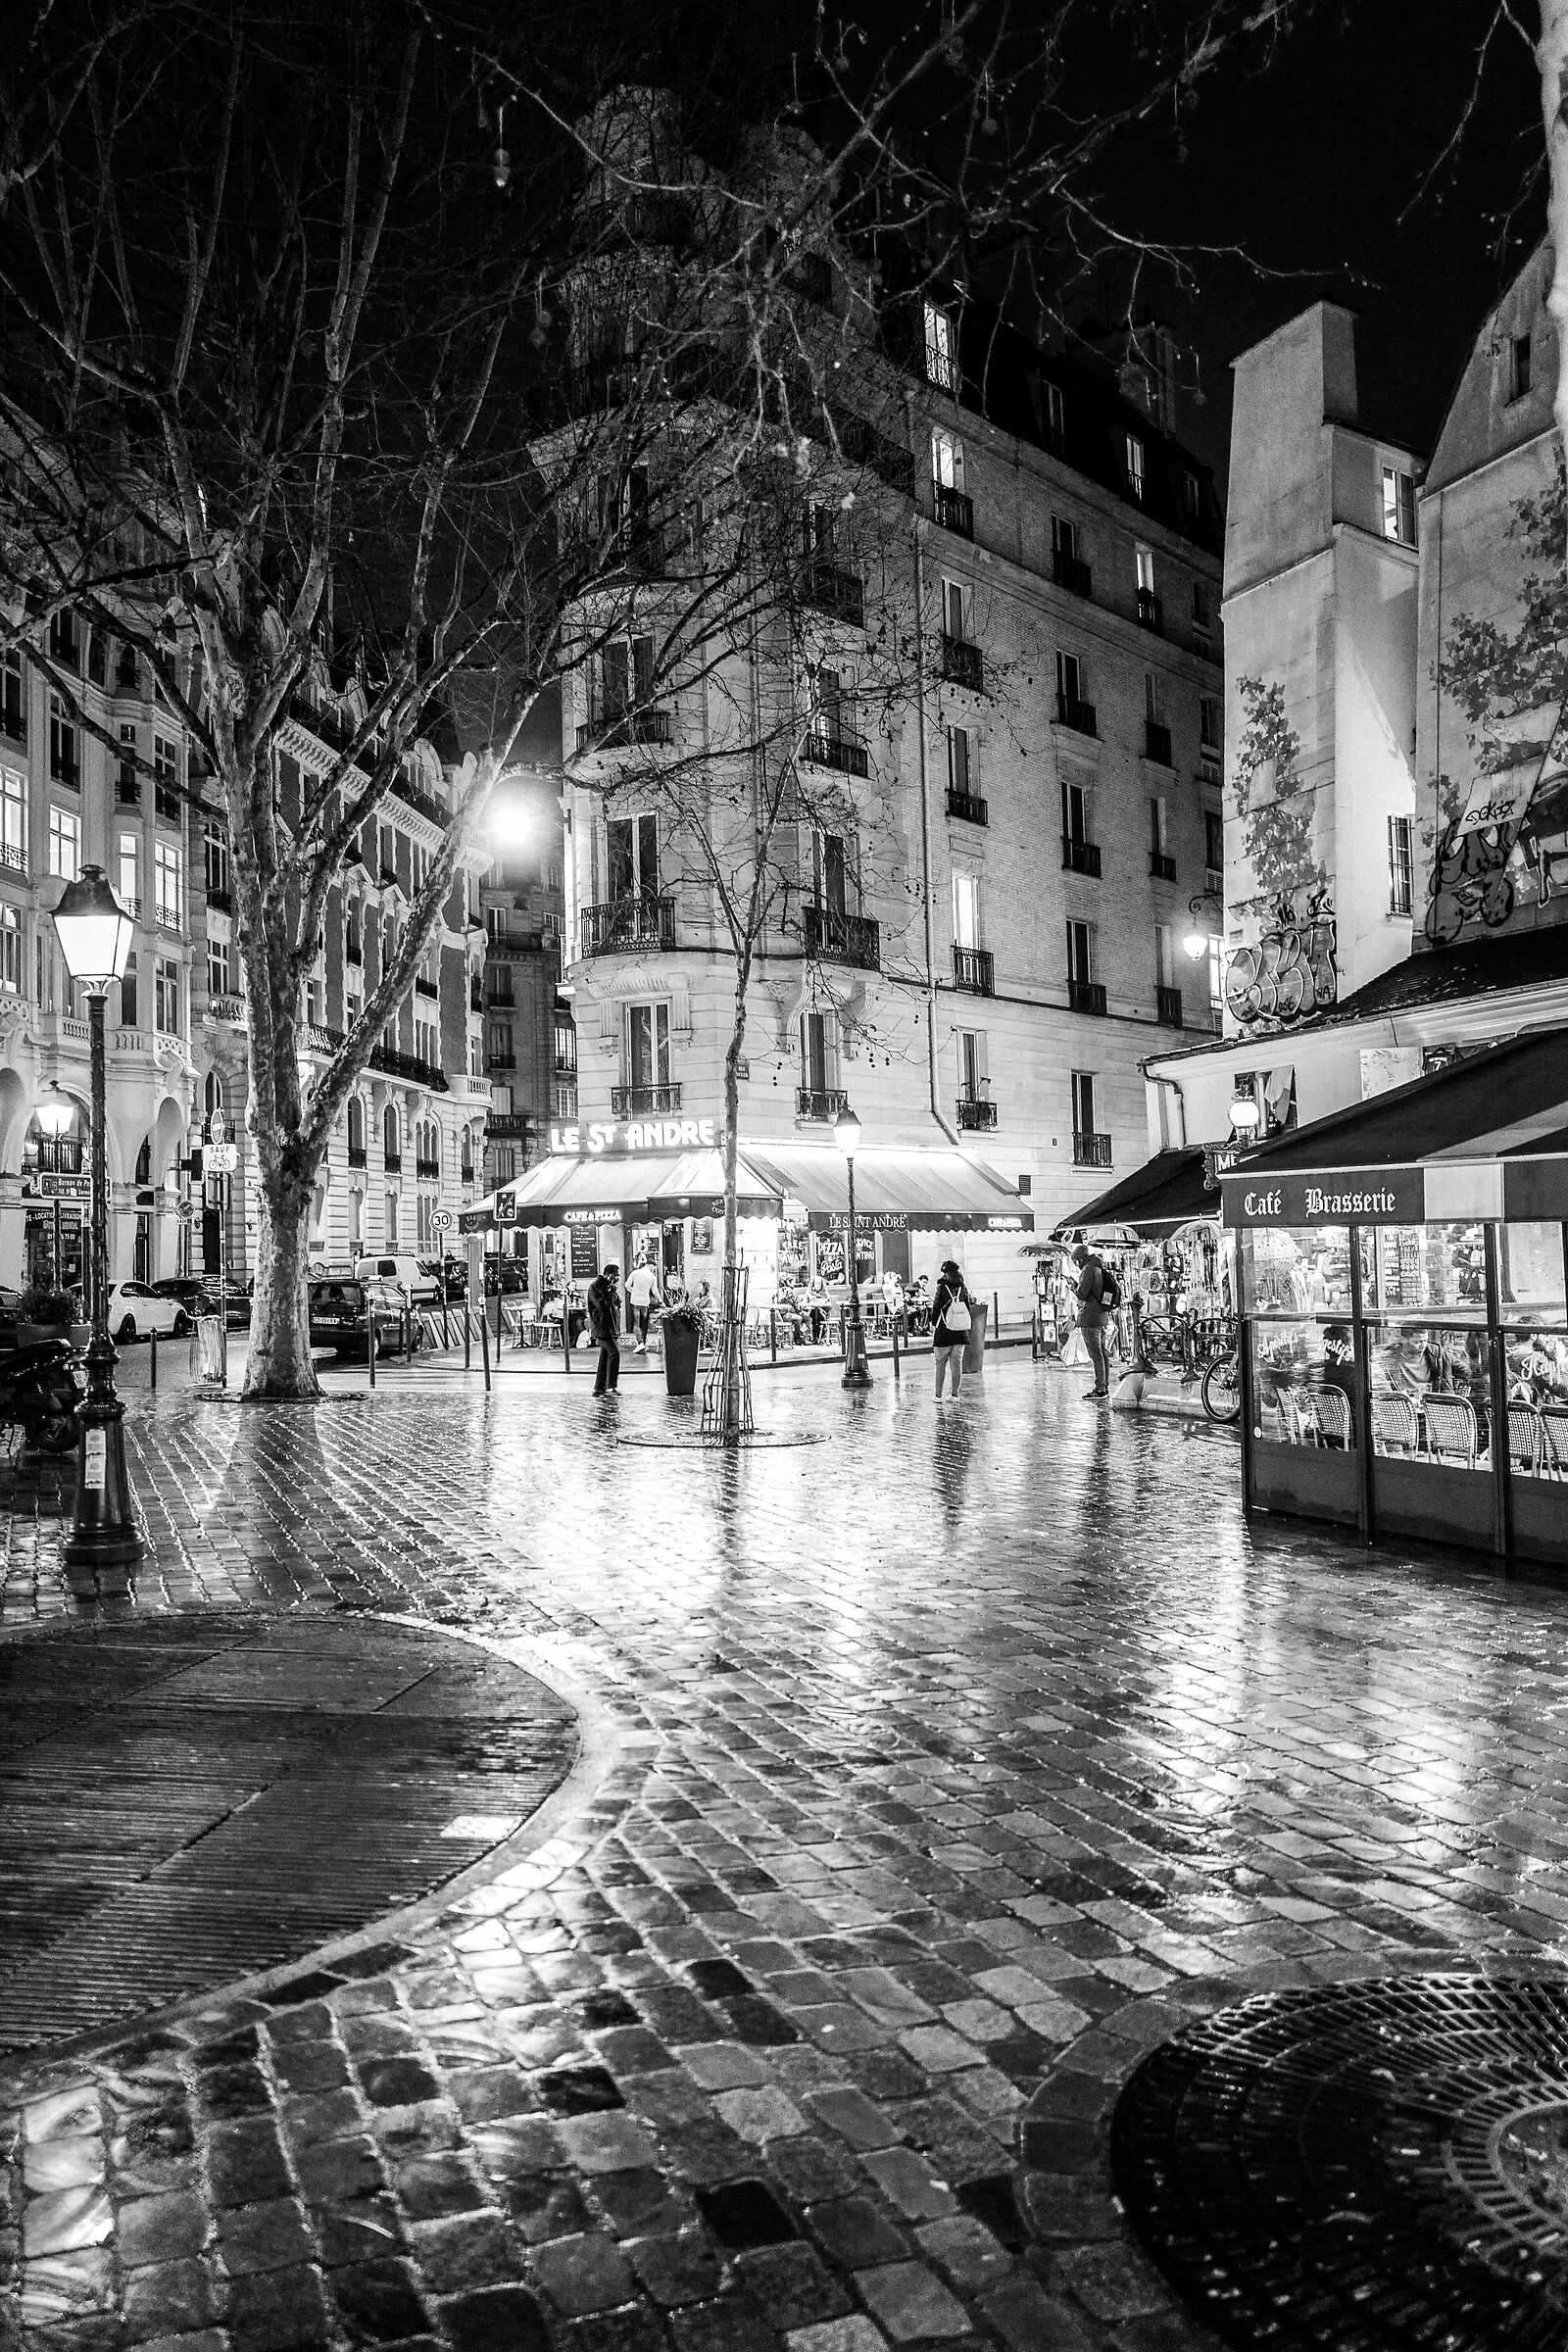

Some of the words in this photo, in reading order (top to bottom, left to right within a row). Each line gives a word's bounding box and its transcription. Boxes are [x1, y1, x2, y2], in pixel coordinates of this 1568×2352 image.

[551, 1127, 579, 1152] LE
[1245, 1189, 1282, 1216] Café
[1304, 1187, 1396, 1218] Brasserie
[35, 1211, 55, 1220] LOCATIO
[434, 1215, 449, 1226] 30
[829, 1216, 842, 1228] LE
[843, 1216, 871, 1228] SINT
[856, 1251, 874, 1260] NTINU
